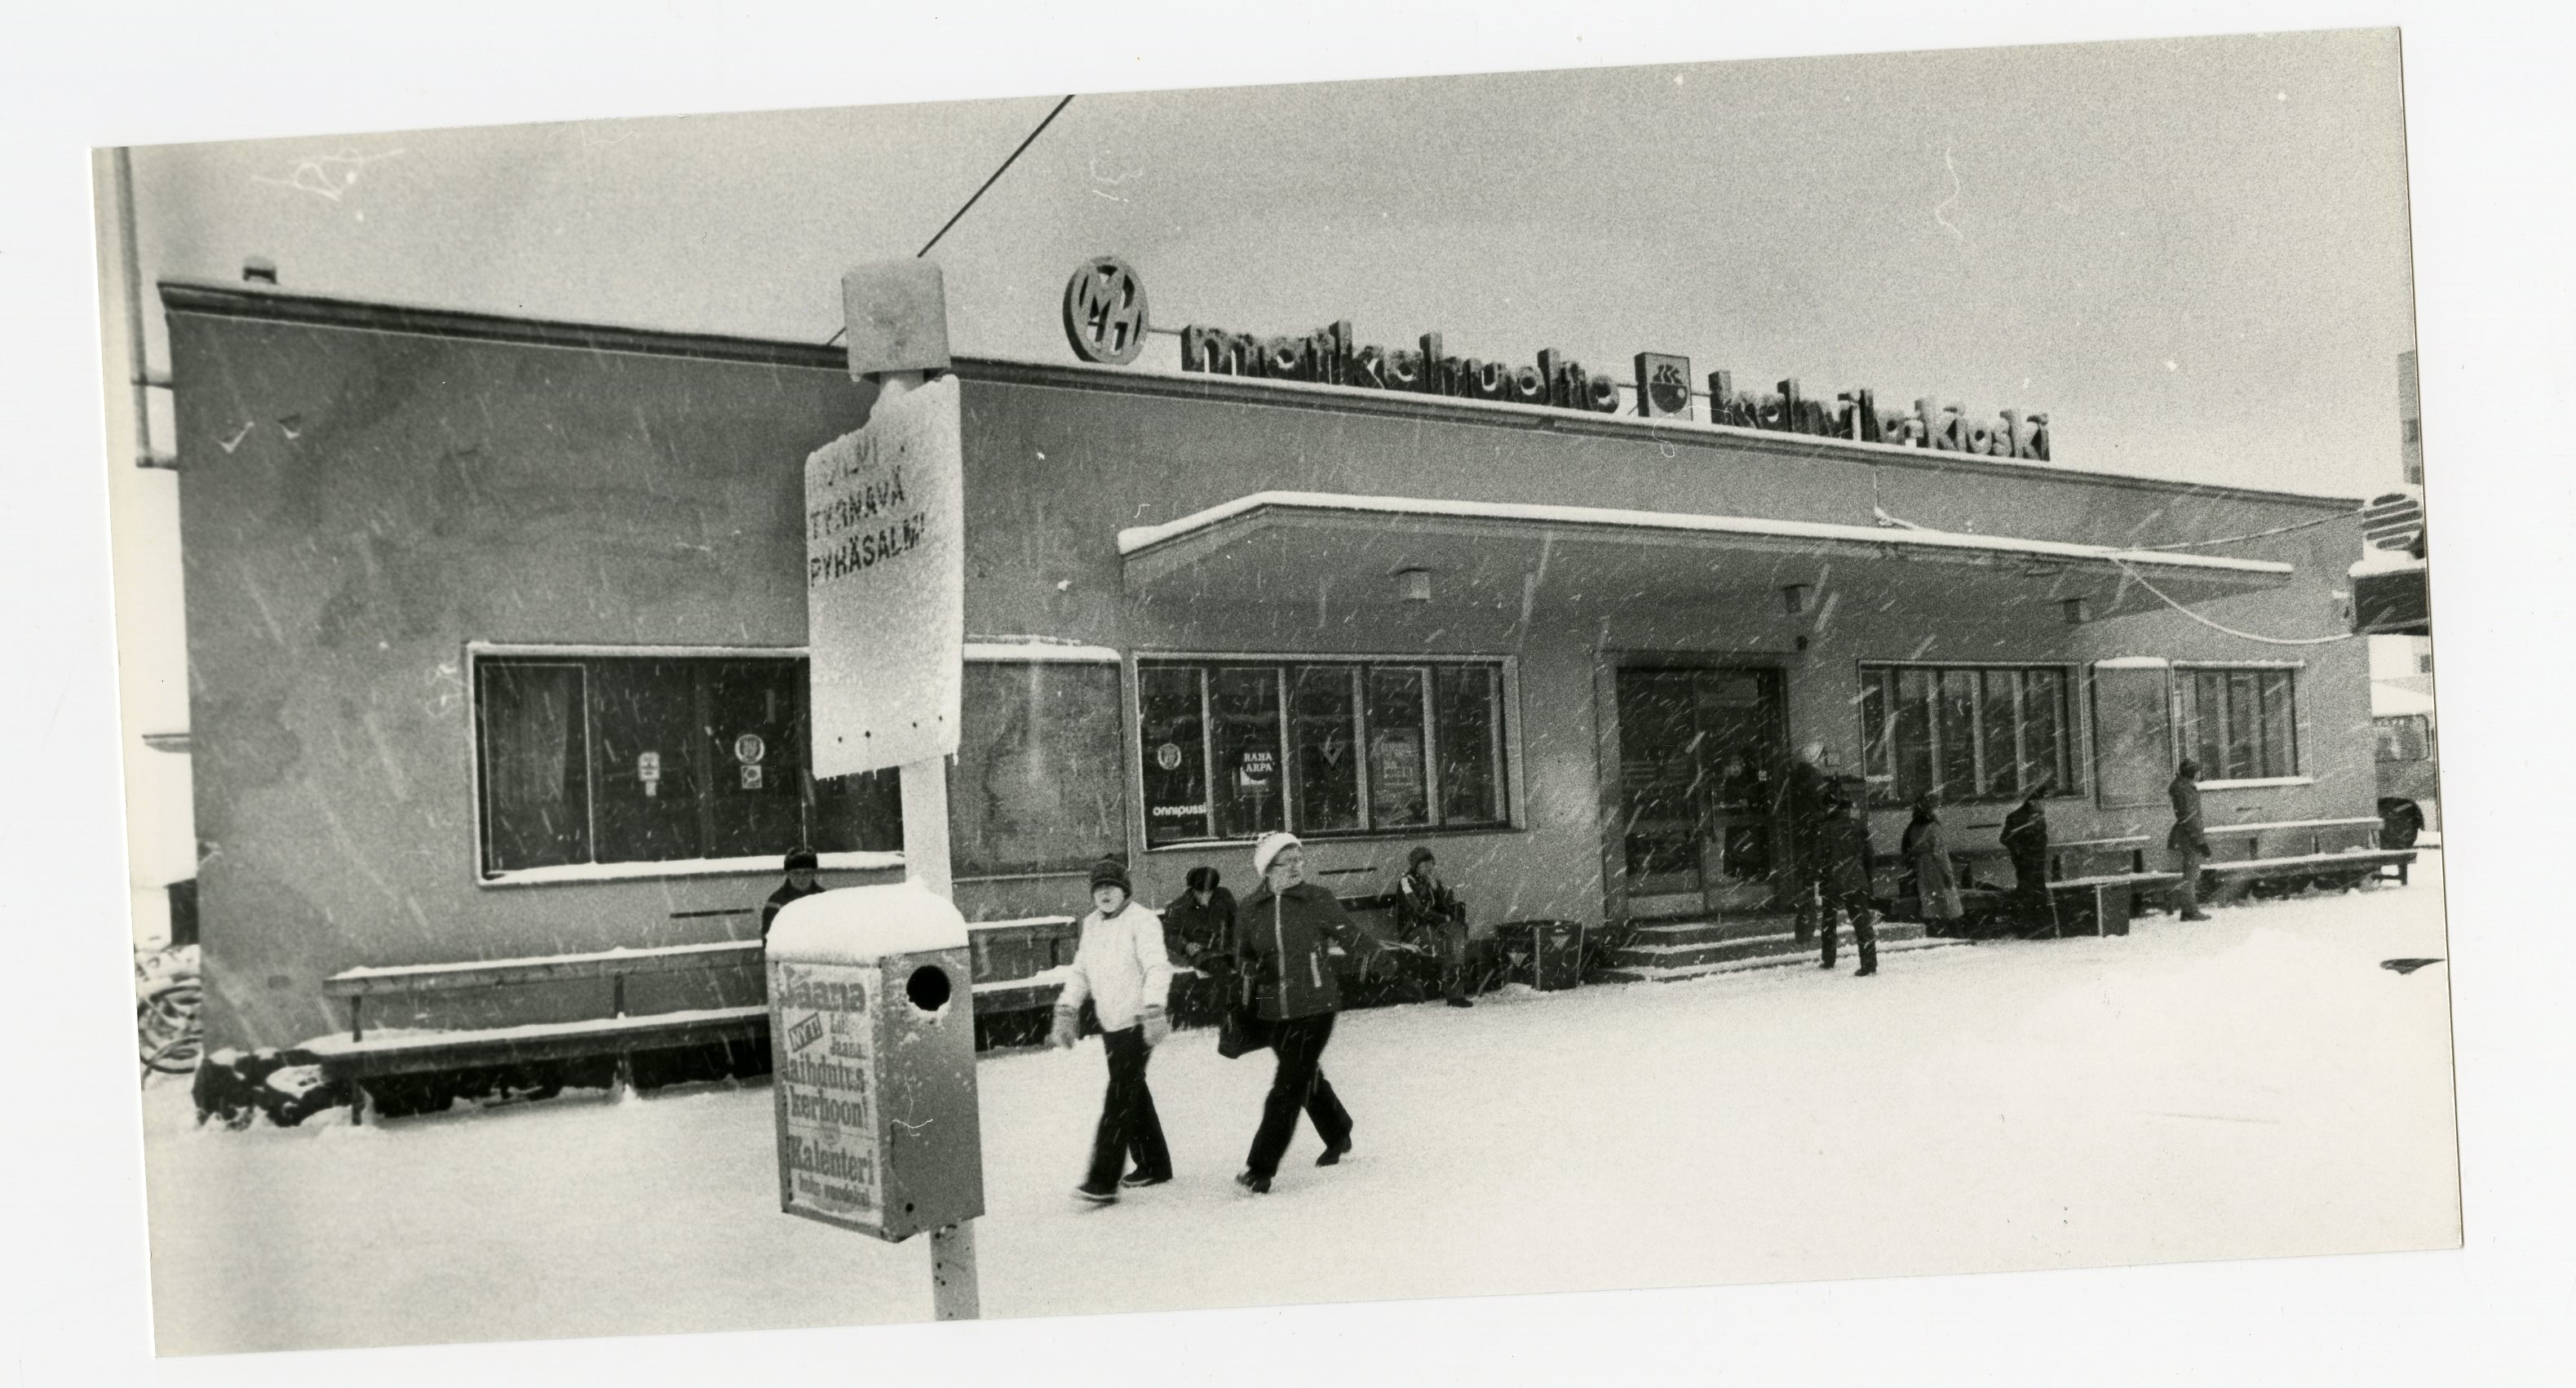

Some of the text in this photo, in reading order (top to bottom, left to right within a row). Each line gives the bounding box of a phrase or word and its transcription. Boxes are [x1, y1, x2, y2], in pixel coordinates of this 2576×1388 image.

[1181, 321, 1619, 415] matkahuolto
[810, 512, 926, 588] PYHÄSALMI
[1246, 763, 1273, 772] ARPA
[1152, 801, 1207, 818] onnipussi
[785, 1135, 876, 1186] Kalenteri
